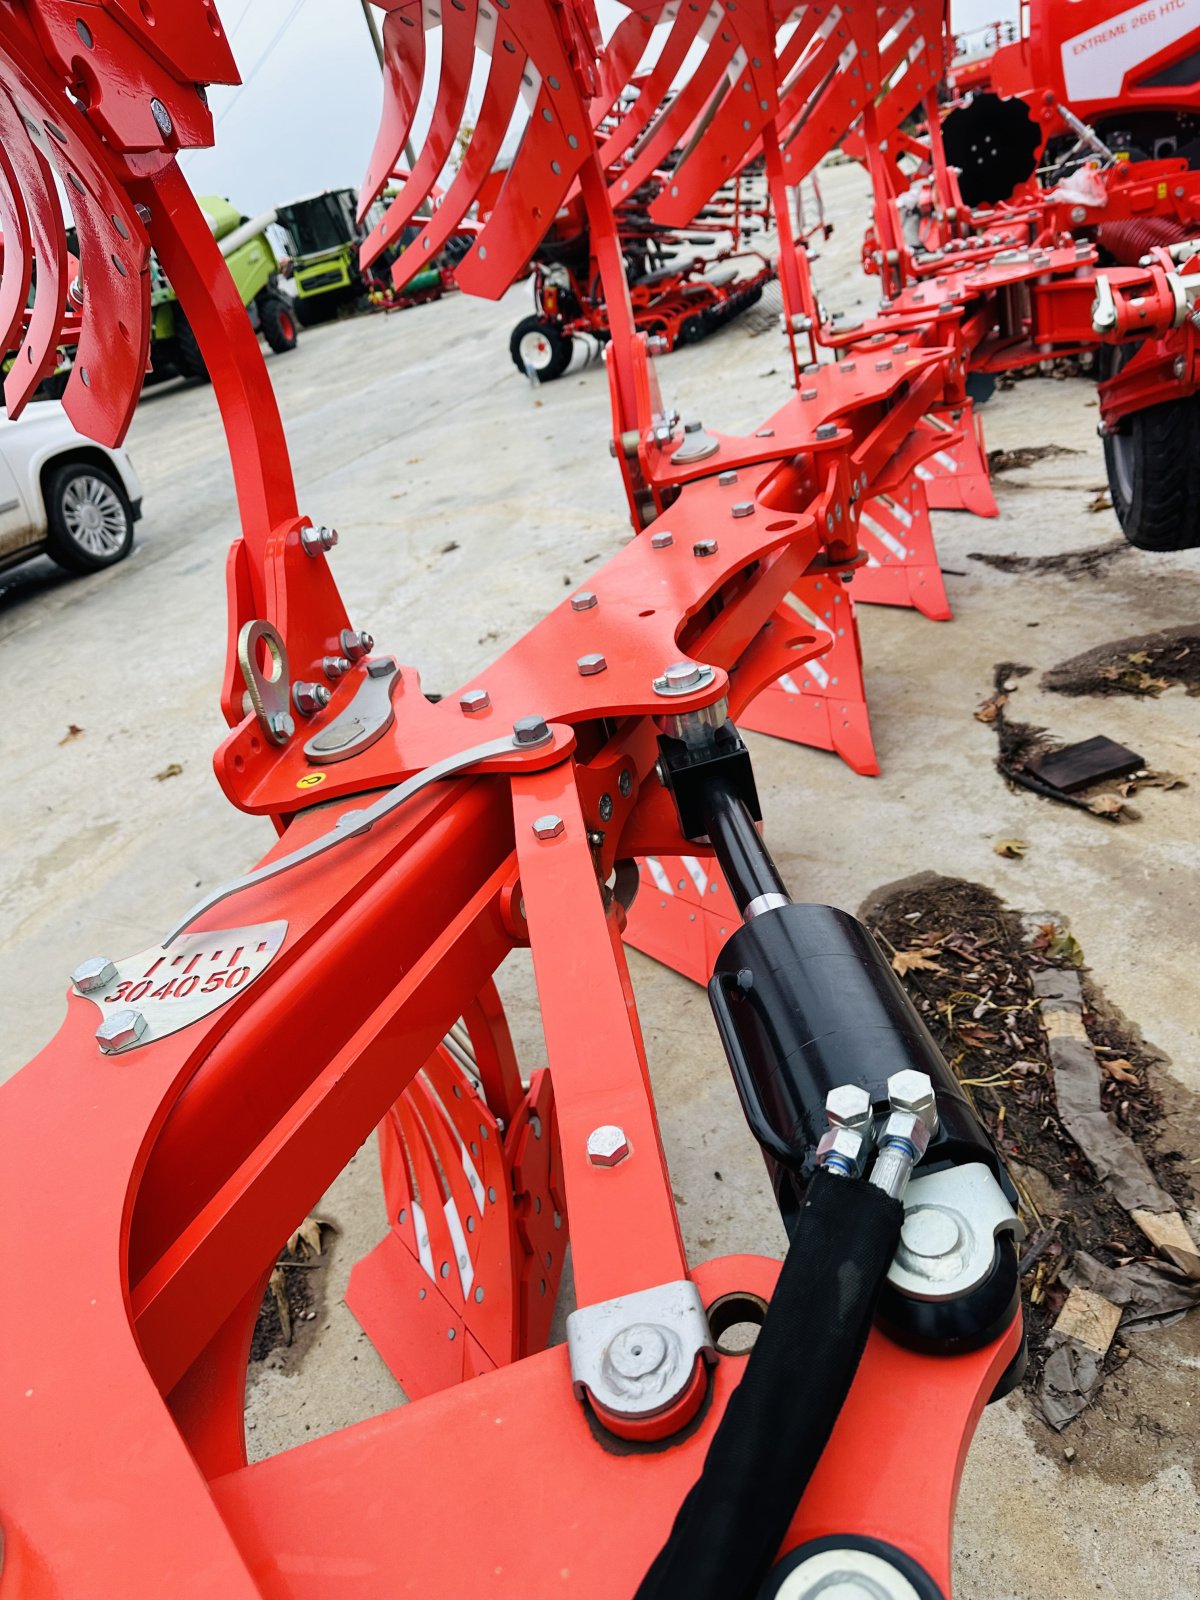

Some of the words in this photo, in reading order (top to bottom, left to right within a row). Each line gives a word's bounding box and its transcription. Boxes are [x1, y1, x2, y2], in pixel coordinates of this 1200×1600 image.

[1072, 24, 1127, 55] EXTREME
[1131, 10, 1156, 29] 266
[1160, 0, 1185, 16] HTC
[104, 980, 153, 1002] 30
[151, 975, 200, 1000] 40
[201, 966, 251, 993] 50
